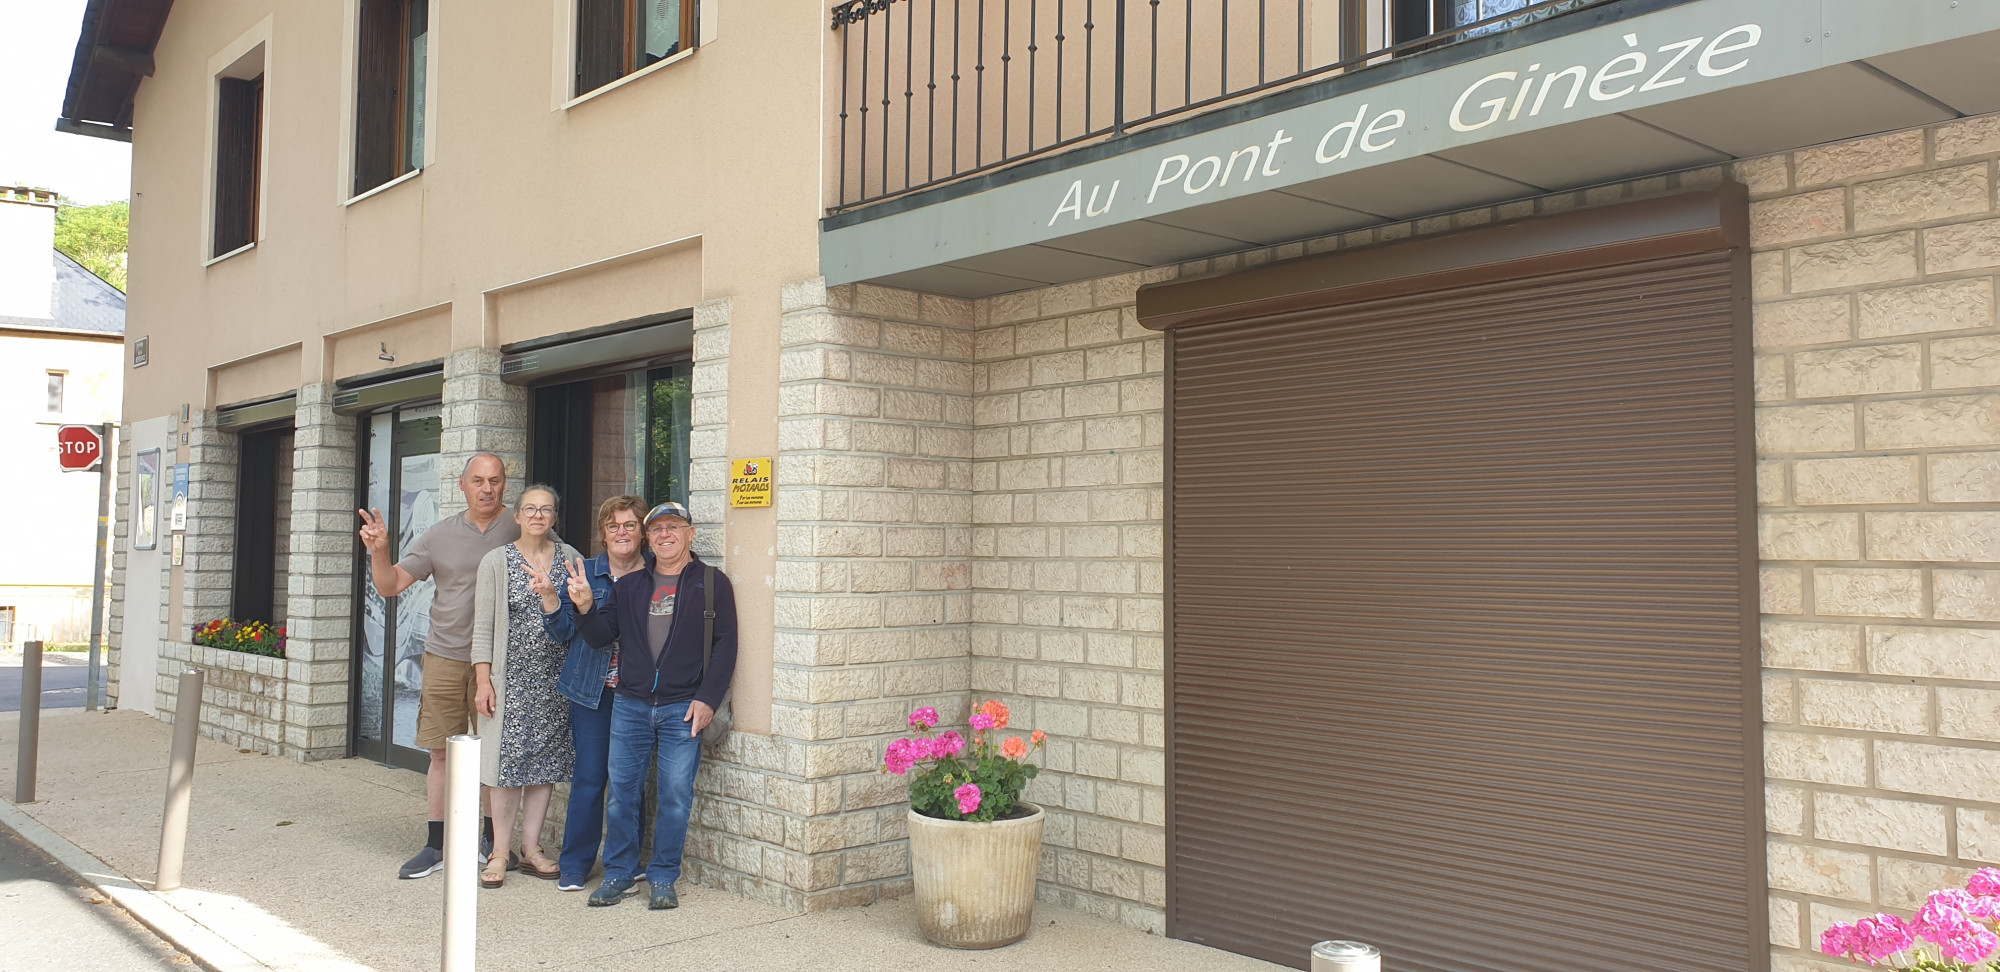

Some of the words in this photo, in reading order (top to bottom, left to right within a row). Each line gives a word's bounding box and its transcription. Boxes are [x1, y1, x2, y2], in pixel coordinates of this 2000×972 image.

[1047, 179, 1121, 227] Au
[1146, 129, 1293, 204] Pont
[1314, 103, 1406, 164] de
[1448, 23, 1763, 133] Ginèze
[732, 483, 769, 492] MOTARDS
